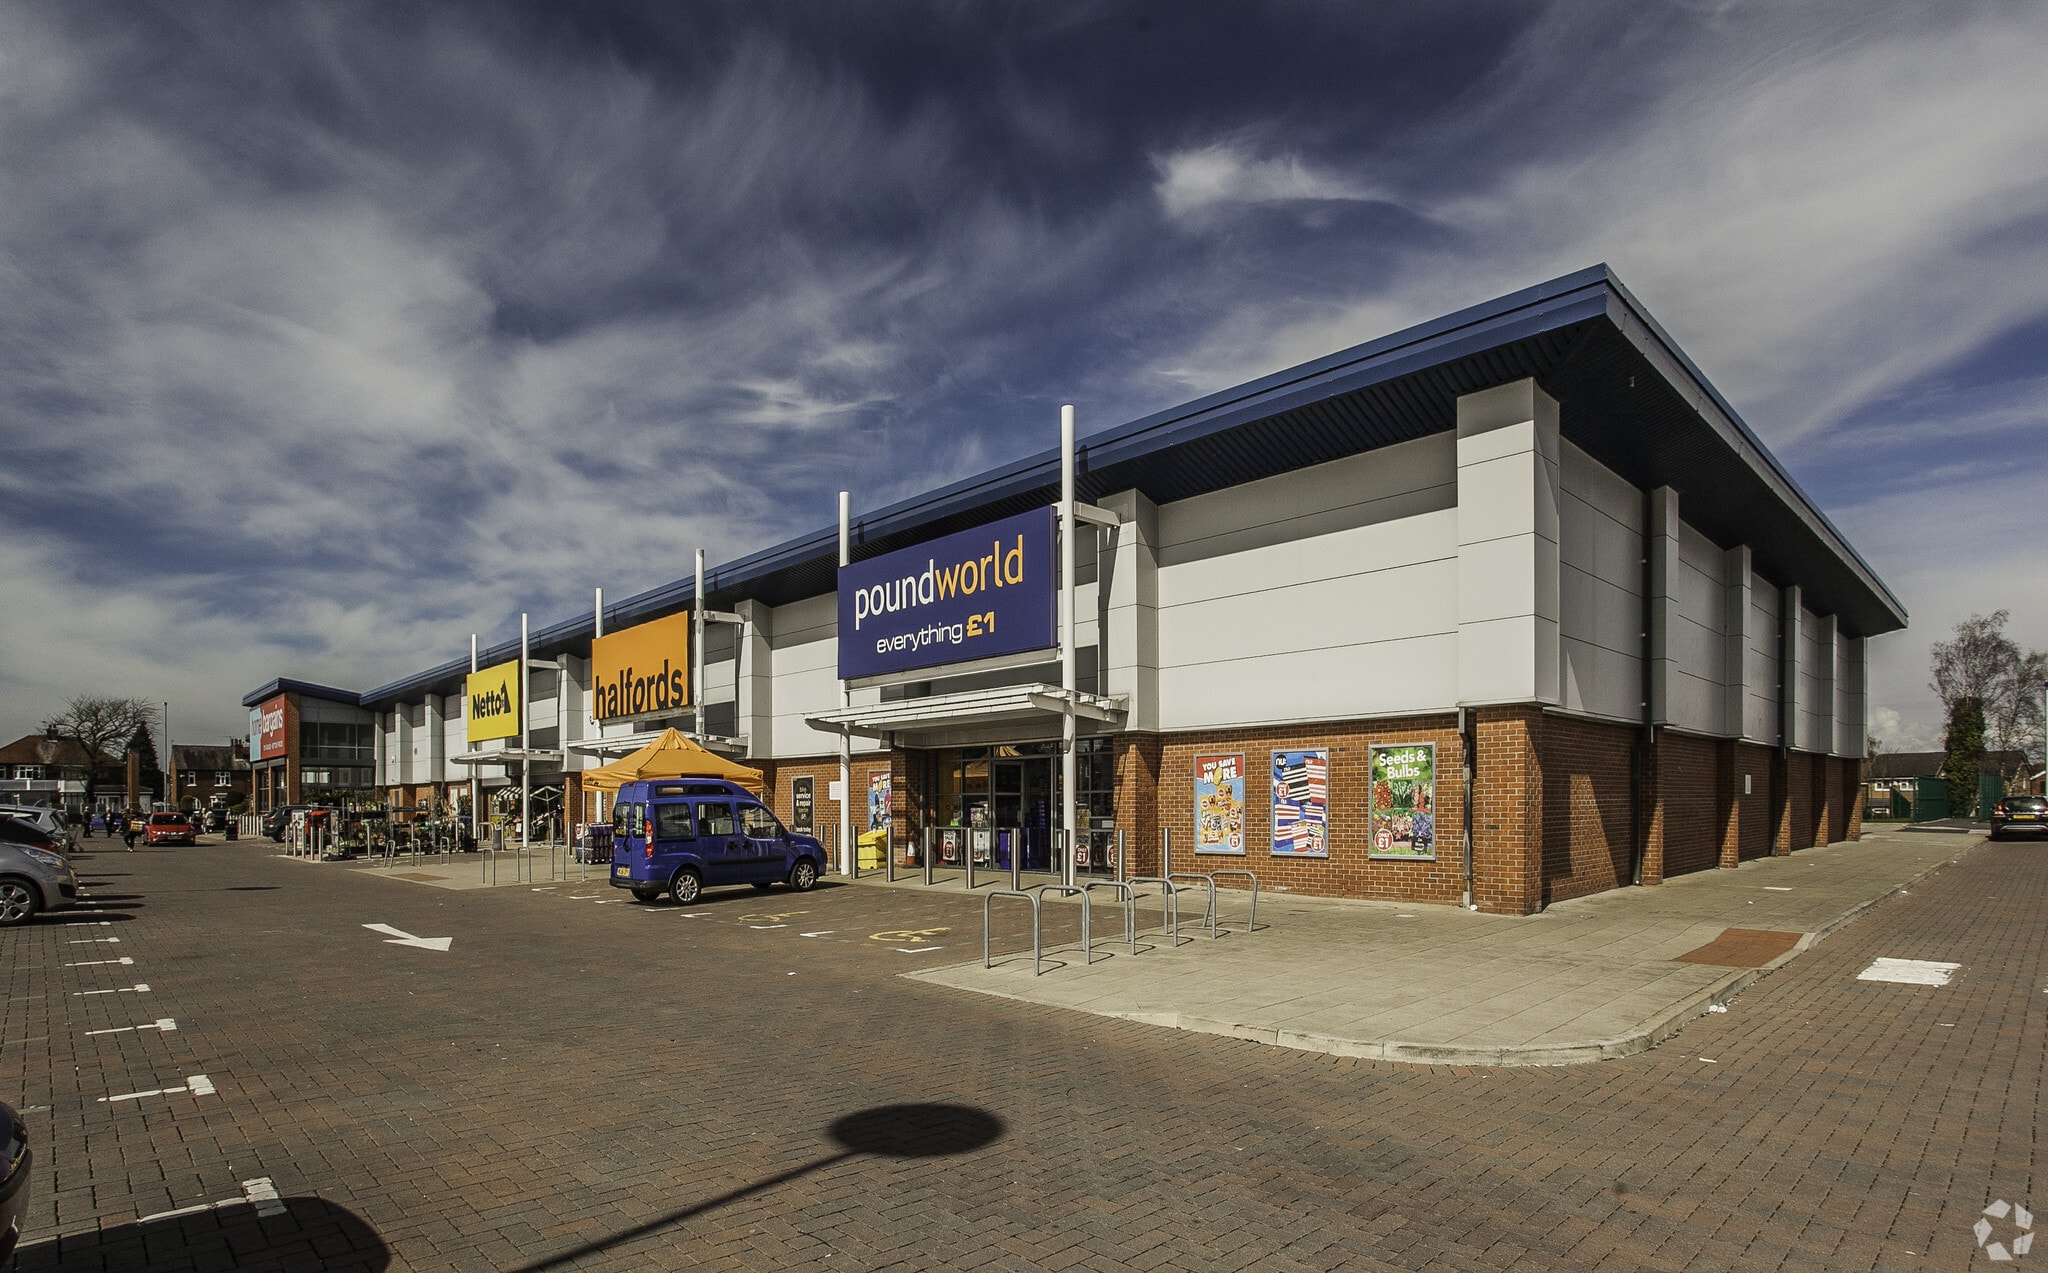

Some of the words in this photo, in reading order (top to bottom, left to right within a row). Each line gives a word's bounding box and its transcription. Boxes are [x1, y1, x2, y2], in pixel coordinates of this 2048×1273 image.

[855, 534, 1023, 631] poundworld
[876, 621, 963, 654] everything
[966, 611, 995, 637] £1
[595, 658, 684, 719] halfords
[472, 690, 501, 720] Netto
[1202, 762, 1217, 771] YOU
[1218, 757, 1236, 768] SAVE
[1379, 750, 1415, 766] Seeds
[1417, 749, 1426, 762] &
[1387, 764, 1420, 779] Bulbs
[1278, 787, 1287, 796] £1
[1313, 840, 1321, 849] £1
[1378, 838, 1389, 848] £1
[1076, 852, 1086, 862] £1
